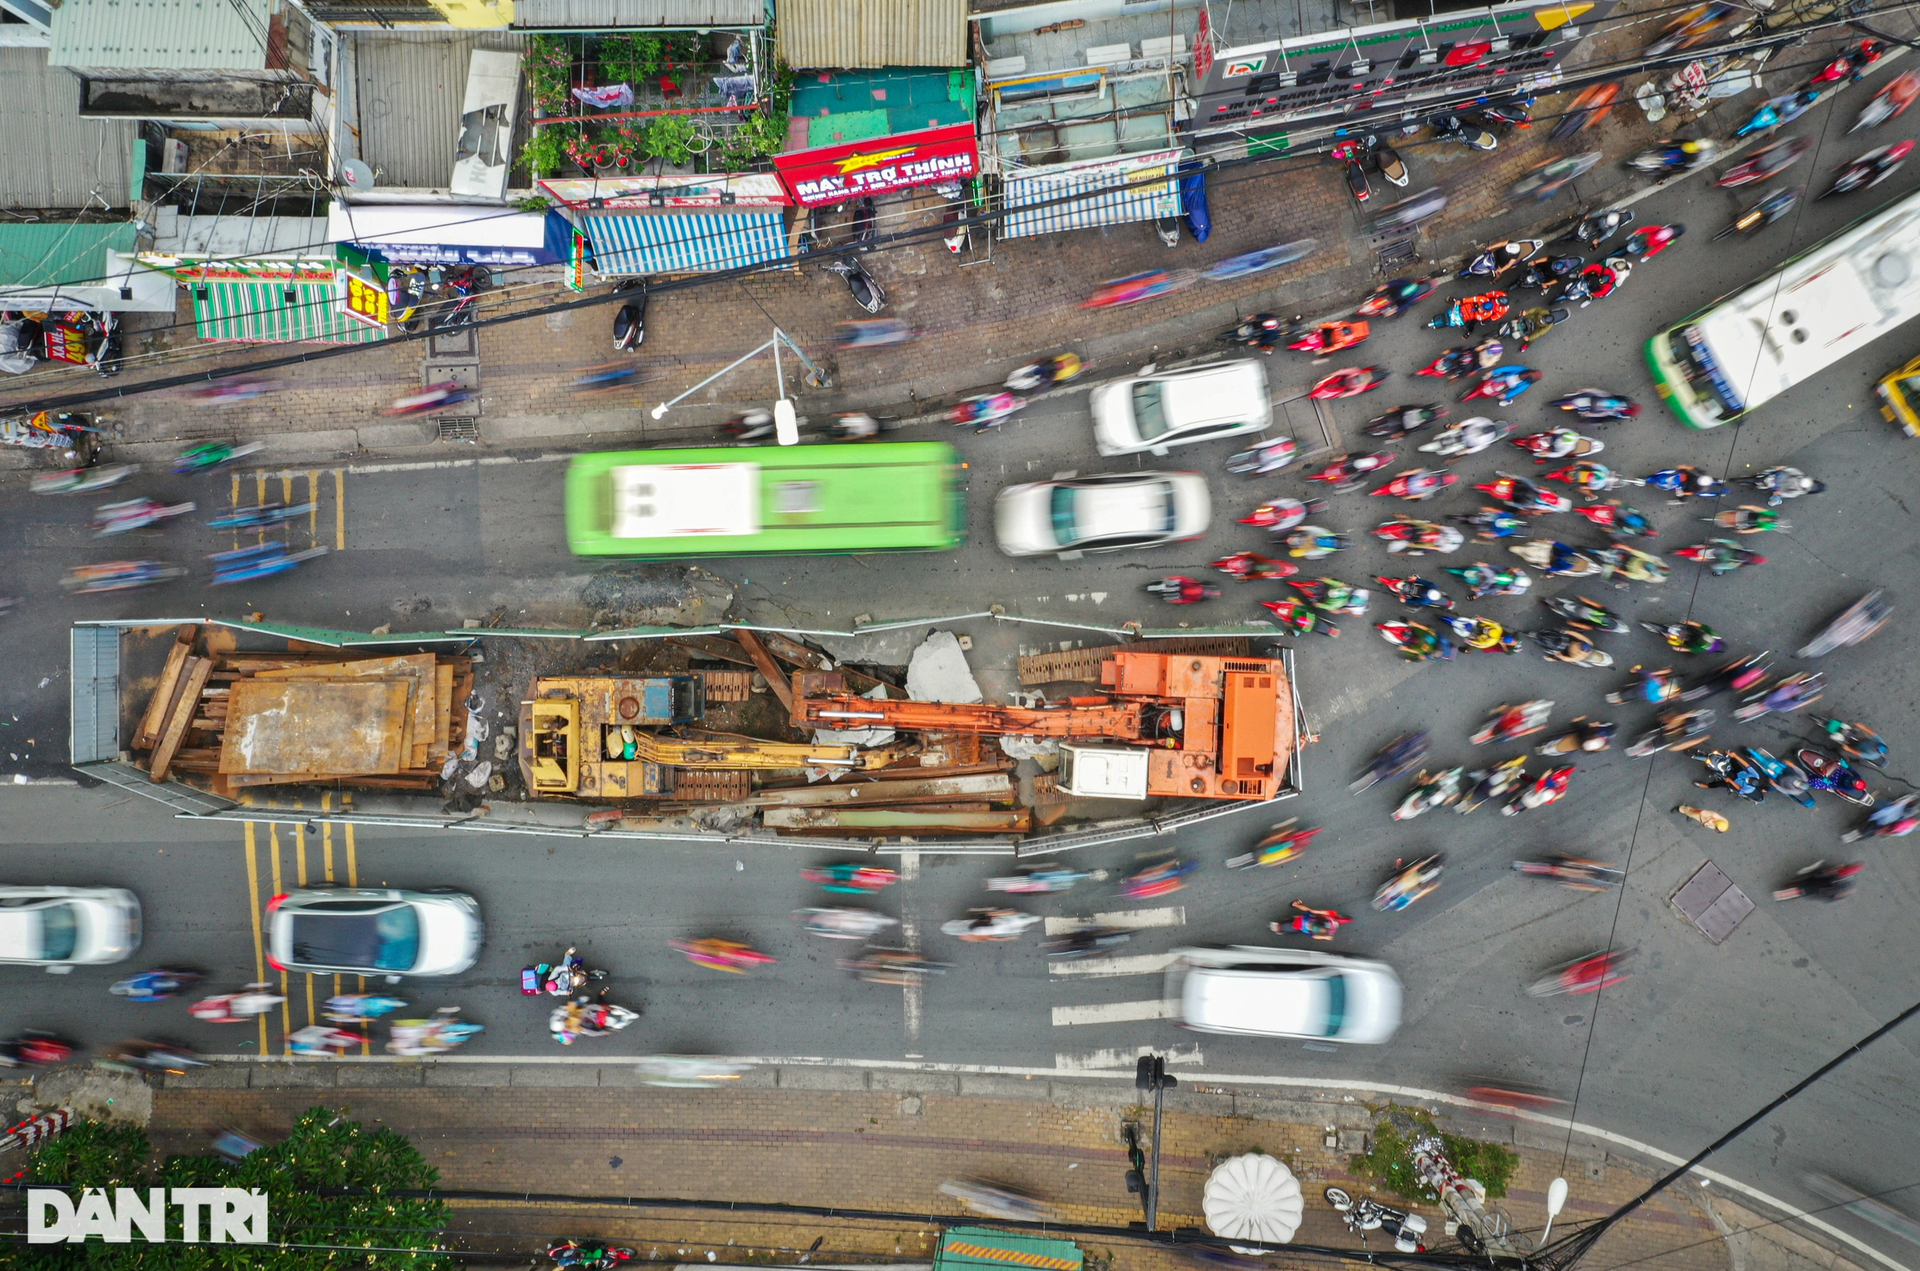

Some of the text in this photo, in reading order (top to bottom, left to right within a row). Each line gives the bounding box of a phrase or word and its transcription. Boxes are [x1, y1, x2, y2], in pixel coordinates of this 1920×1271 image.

[796, 153, 971, 196] MÁY TRỢ THÍNH
[64, 328, 86, 363] 49K
